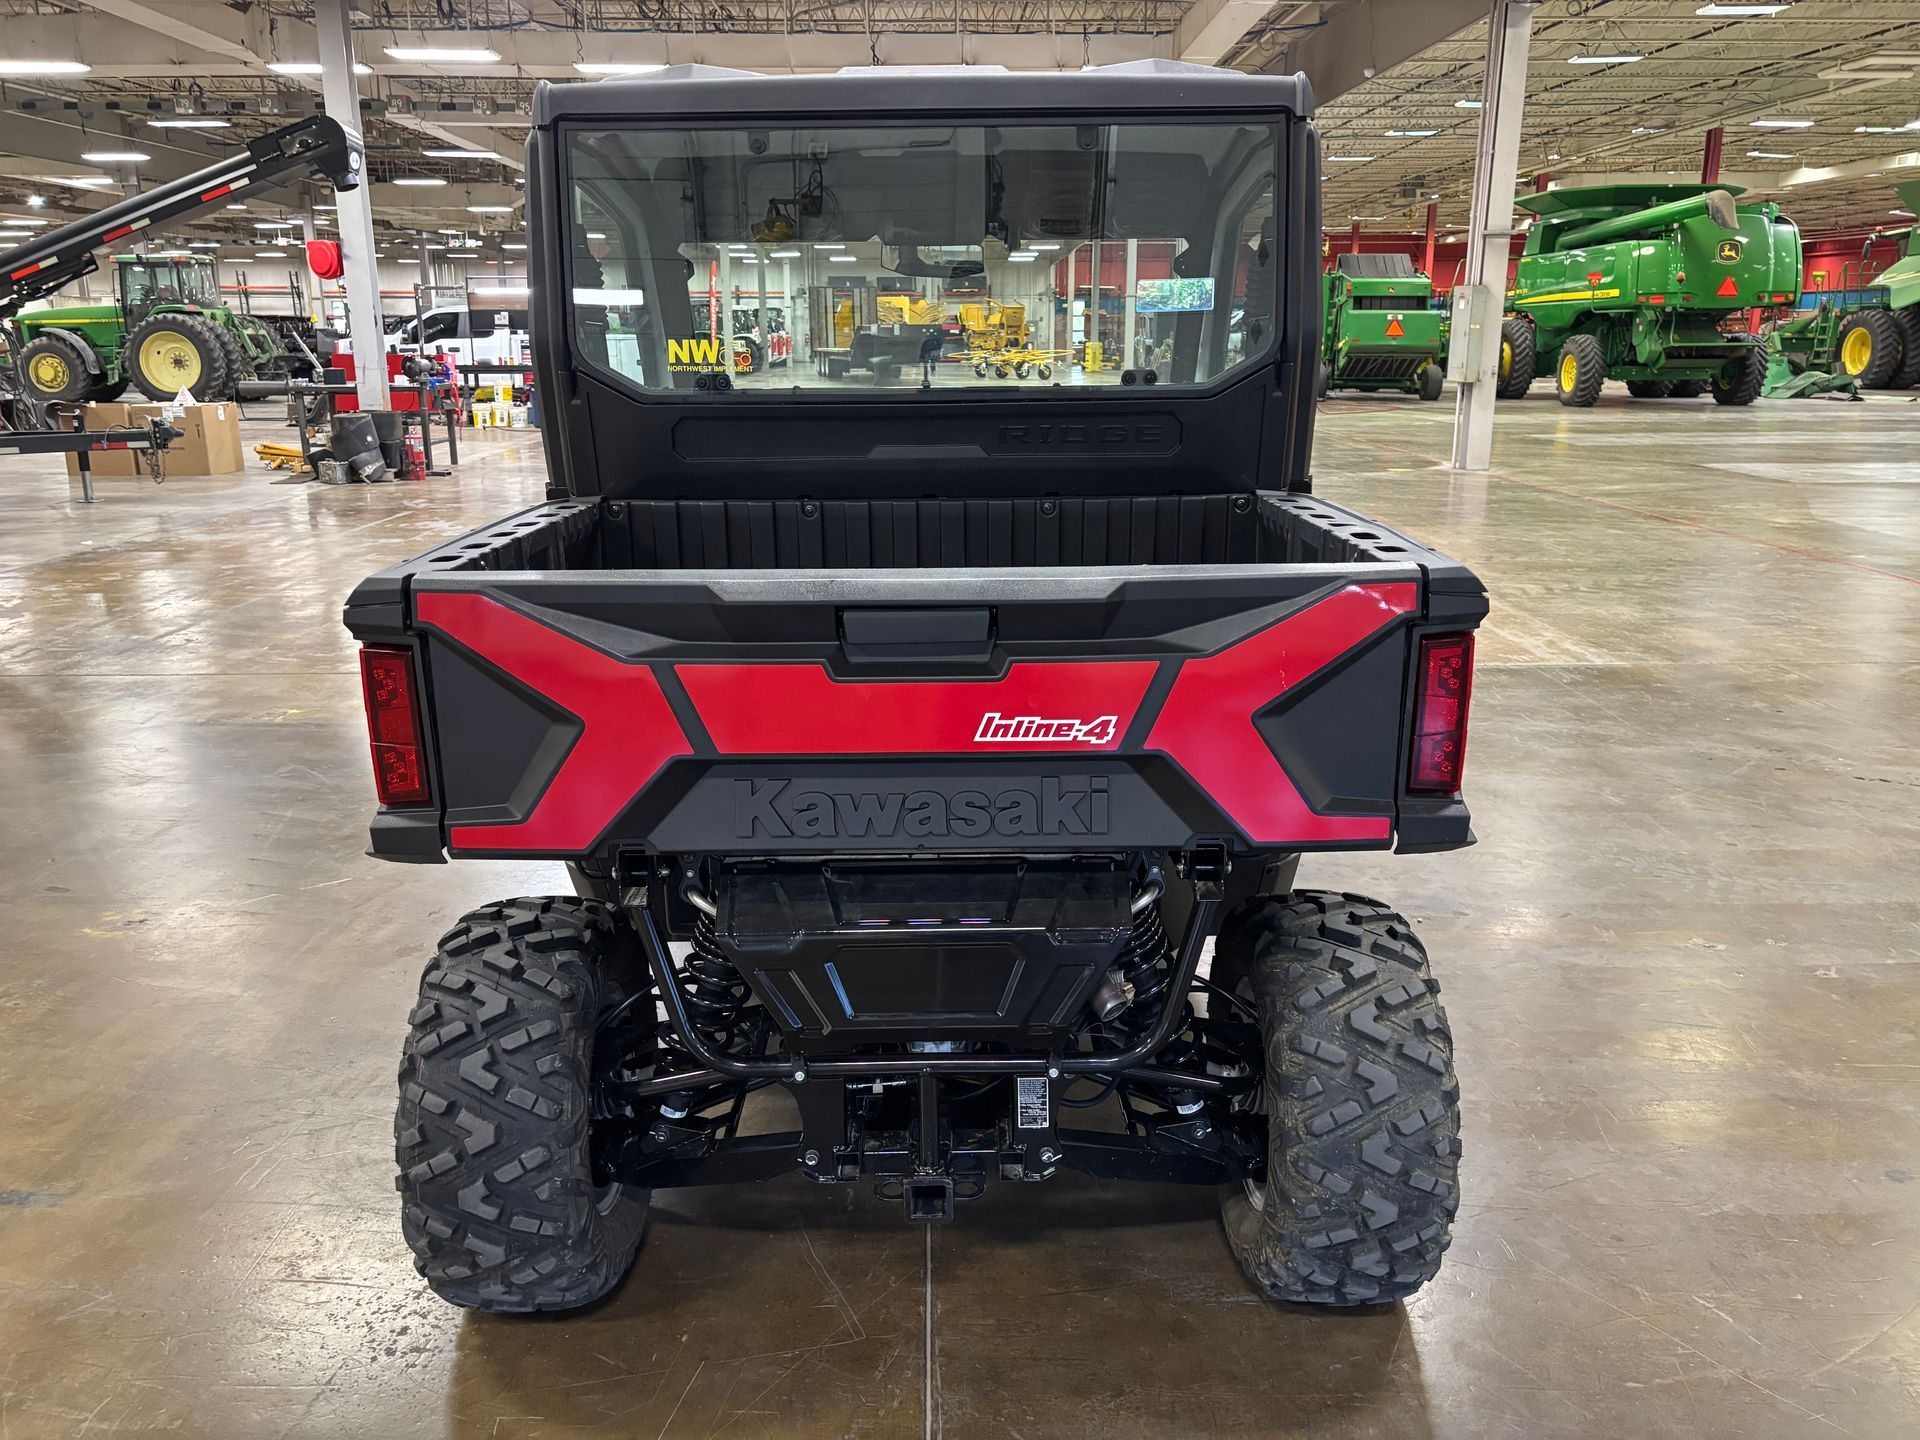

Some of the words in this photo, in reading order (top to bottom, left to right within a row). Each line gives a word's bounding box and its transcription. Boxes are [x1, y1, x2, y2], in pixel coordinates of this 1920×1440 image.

[667, 339, 720, 364] NW
[998, 424, 1165, 445] RIDGE
[973, 712, 1119, 744] Inline-4
[733, 775, 1110, 839] Kawasaki
